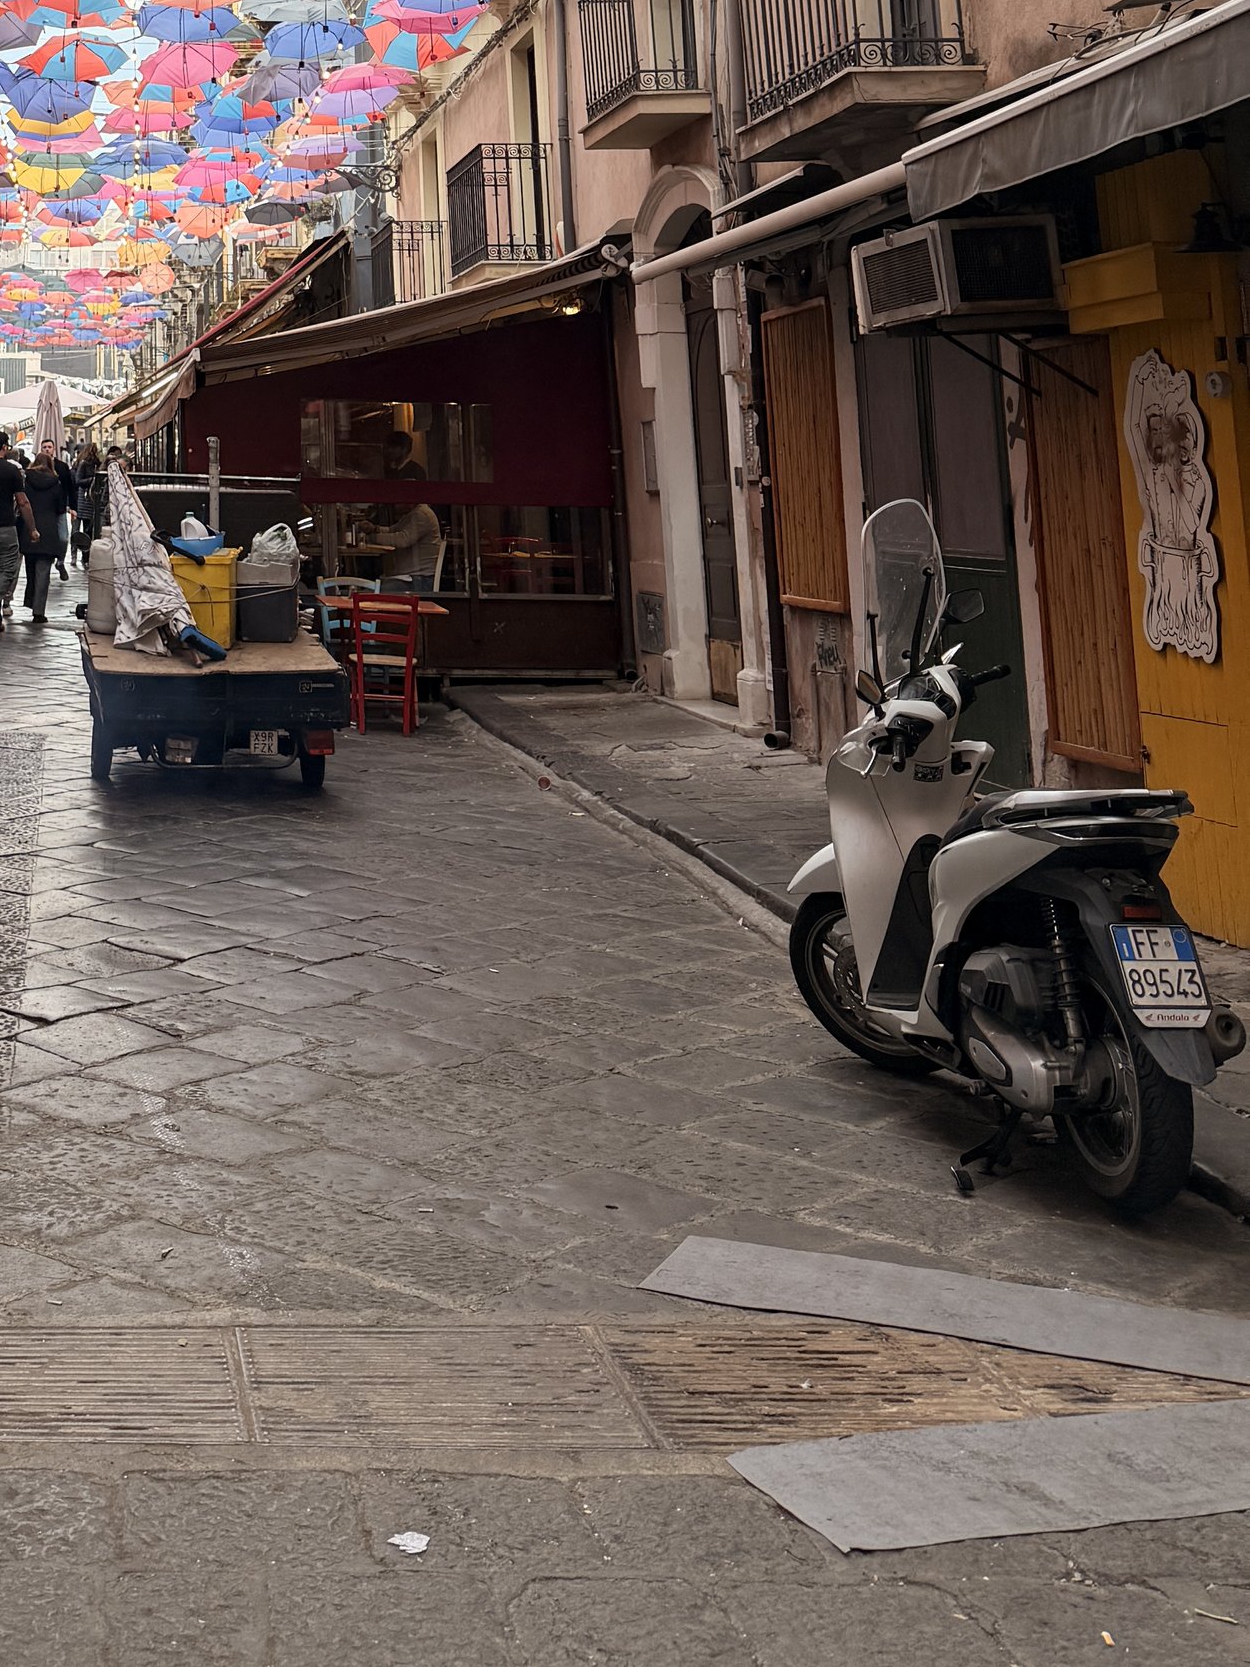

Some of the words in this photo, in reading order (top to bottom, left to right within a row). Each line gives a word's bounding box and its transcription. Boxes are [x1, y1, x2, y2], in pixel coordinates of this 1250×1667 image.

[253, 731, 274, 742] X9R
[253, 743, 274, 754] FZK
[1131, 928, 1160, 959] FF
[1128, 968, 1203, 999] 89543
